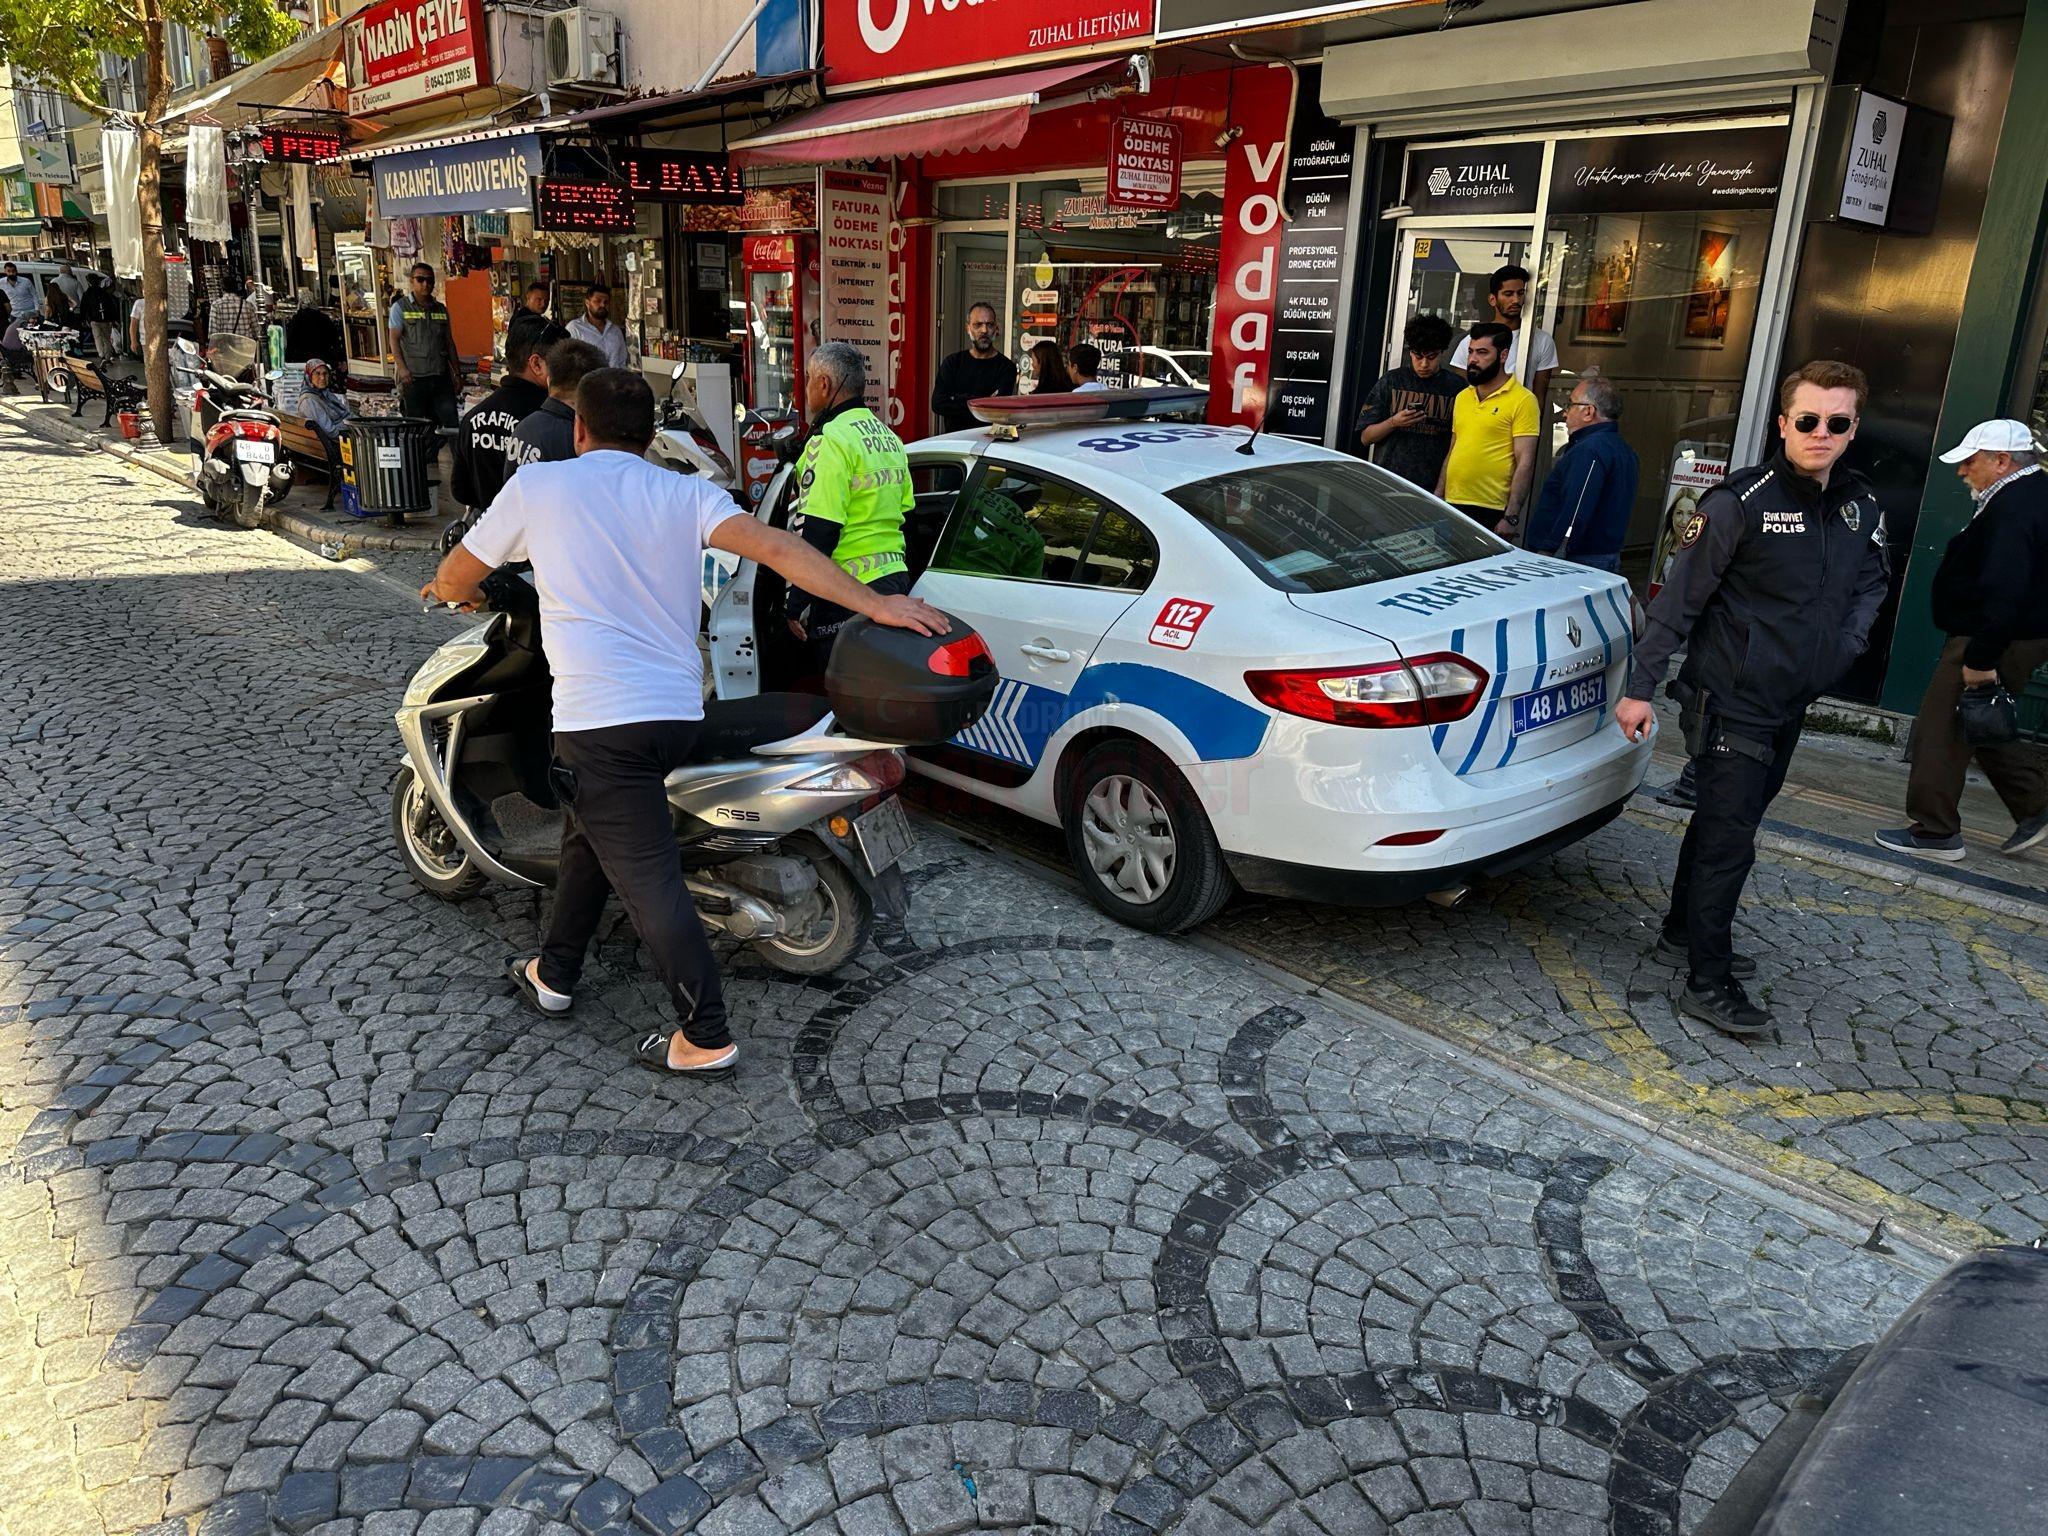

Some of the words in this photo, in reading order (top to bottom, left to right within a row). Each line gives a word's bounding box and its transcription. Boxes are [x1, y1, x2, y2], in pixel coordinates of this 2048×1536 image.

[366, 8, 414, 63] NARİN
[1028, 23, 1074, 48] ZUHAL
[1078, 9, 1141, 37] İLETİŞİM
[445, 70, 455, 84] 237
[1122, 121, 1173, 139] FATURA
[1124, 135, 1170, 155] ÖDEME
[1310, 140, 1335, 152] DÜĞÜN
[1118, 153, 1174, 172] NOKTASI
[1293, 153, 1350, 167] FOTOĞRAFÇILIĞI
[1857, 147, 1887, 173] ZUHAL
[384, 159, 444, 200] KARANFİL
[444, 147, 528, 196] KURUYEMİŞ
[1120, 171, 1141, 181] ZUHAL
[1457, 164, 1510, 182] ZUHAL
[1450, 183, 1514, 198] Fotoğrafçılık
[1306, 192, 1331, 204] DÜĞÜN
[740, 200, 791, 220] karanfil
[832, 200, 880, 215] FATURA
[1064, 196, 1107, 216] ZUHAL
[1307, 206, 1327, 218] FİLMİ
[834, 216, 878, 232] ÖDEME
[1089, 216, 1117, 229] MURAT
[829, 235, 883, 251] NOKTASI
[1289, 245, 1338, 255] PROFESYONEL
[832, 259, 866, 269] ELEKTRİK
[1288, 260, 1312, 269] DRONE
[1312, 258, 1337, 270] ÇEKİMİ
[838, 276, 875, 287] İNTERNET
[838, 298, 874, 306] VODAFONE
[1288, 297, 1299, 305] 4K
[1299, 297, 1317, 306] FULL
[1318, 297, 1328, 306] HD
[1283, 309, 1307, 319] DÜĞÜN
[1308, 309, 1331, 320] ÇEKİMİ
[850, 338, 880, 346] TELEKOM
[1286, 351, 1297, 360] DIŞ
[1298, 350, 1319, 360] ÇEKİM
[1282, 395, 1293, 405] DIŞ
[1294, 395, 1314, 405] ÇEKİM
[1288, 407, 1306, 418] FİLMİ
[470, 411, 519, 433] TRAFİK
[1376, 574, 1517, 616] TRAFİK
[1165, 603, 1202, 628] 112
[1163, 629, 1180, 639] ACİL
[1550, 654, 1603, 680] FLUENCE
[1514, 720, 1524, 729] TR
[1530, 694, 1551, 723] 48
[1556, 690, 1568, 716] A
[1571, 676, 1604, 711] 8657
